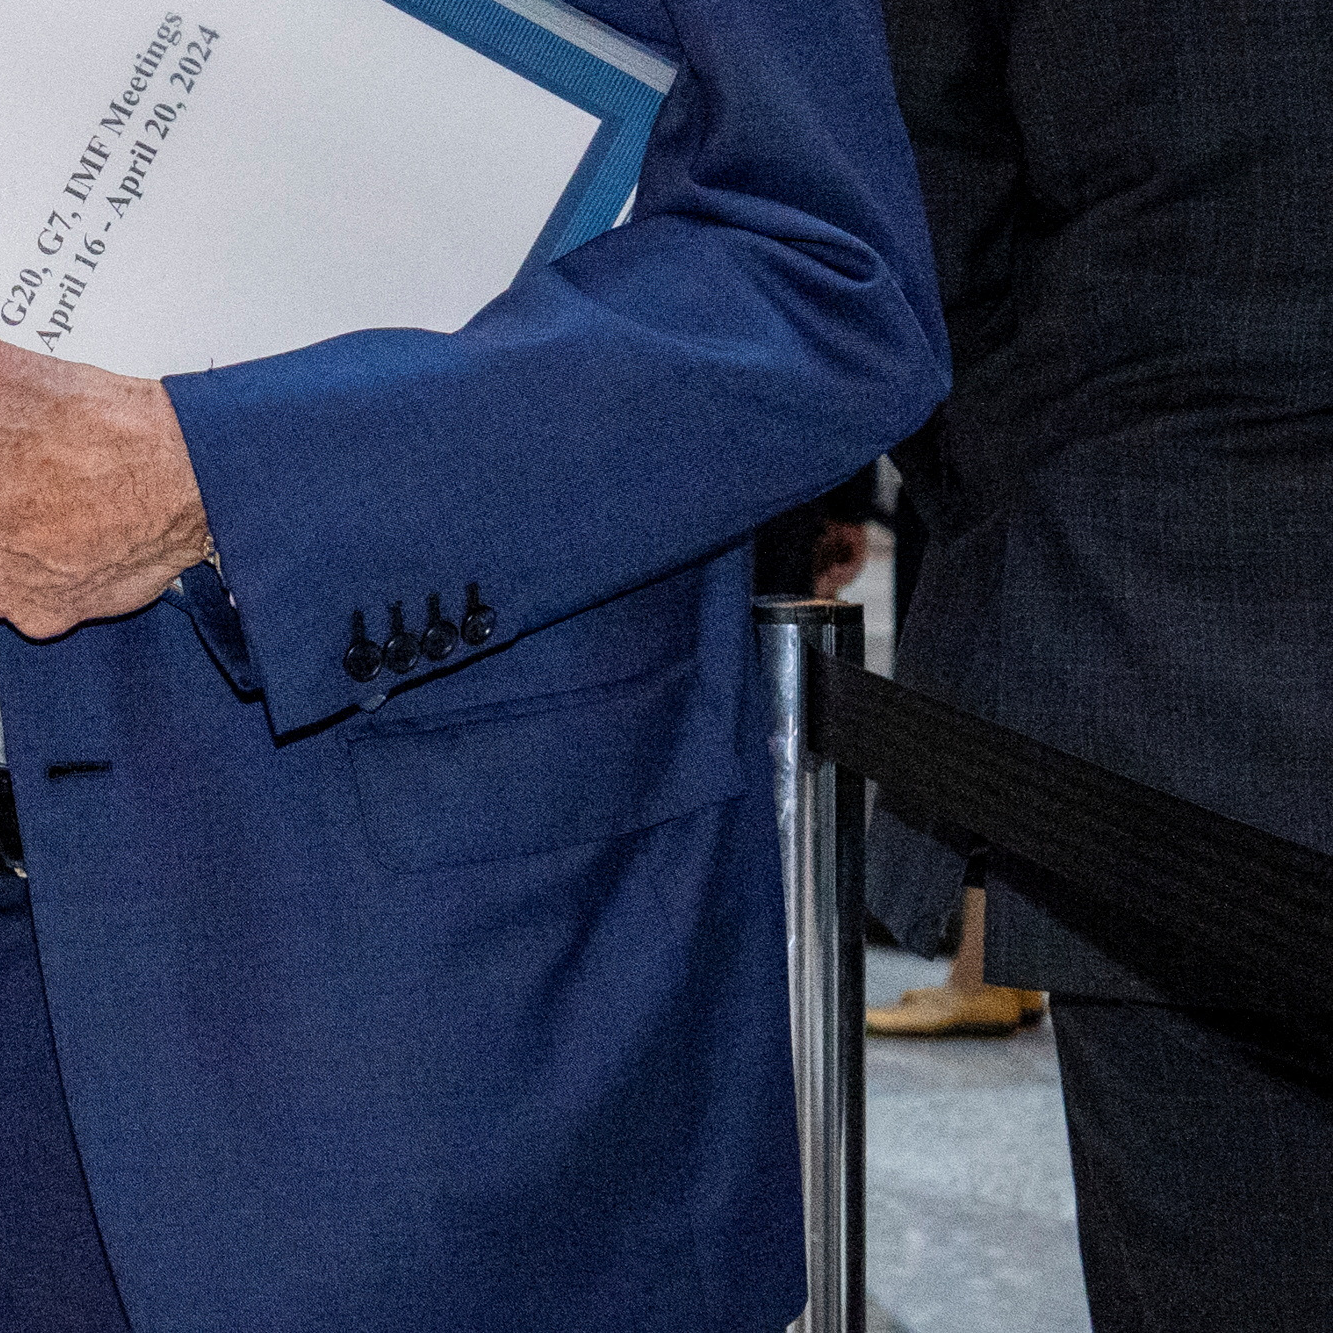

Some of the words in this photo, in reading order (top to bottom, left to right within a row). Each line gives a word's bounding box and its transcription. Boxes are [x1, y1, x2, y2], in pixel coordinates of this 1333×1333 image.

[0, 267, 52, 327] G20,
[36, 209, 82, 256] G7,
[63, 134, 111, 203] IMF
[99, 11, 184, 137] Meetings
[36, 273, 87, 352] April
[74, 232, 107, 271] 16
[105, 140, 158, 219] April
[144, 101, 187, 141] 20,
[169, 24, 221, 94] 2024
